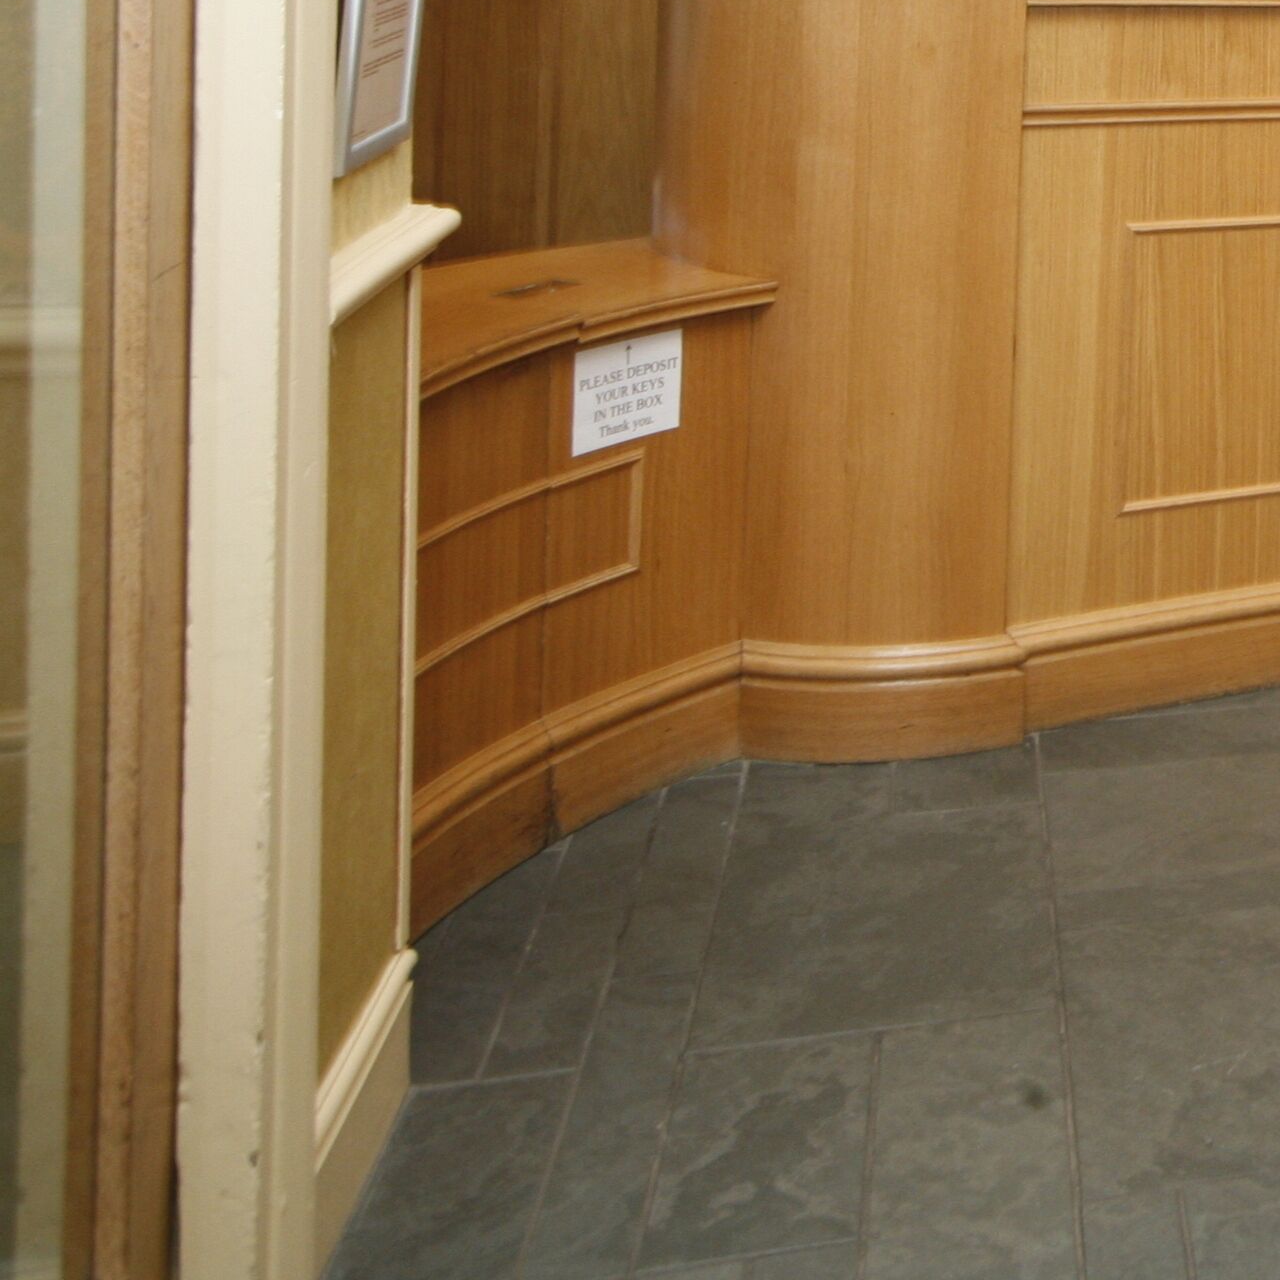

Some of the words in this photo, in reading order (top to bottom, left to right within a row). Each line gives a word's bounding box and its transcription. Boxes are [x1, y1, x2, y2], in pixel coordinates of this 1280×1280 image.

[579, 369, 624, 392] PLEASE
[626, 356, 679, 379] DEPOSIT
[595, 385, 628, 405] YOUR
[631, 377, 665, 395] KEYS
[594, 409, 606, 423] IN
[610, 401, 633, 418] THE
[636, 394, 663, 411] BOX
[600, 420, 629, 438] Thank
